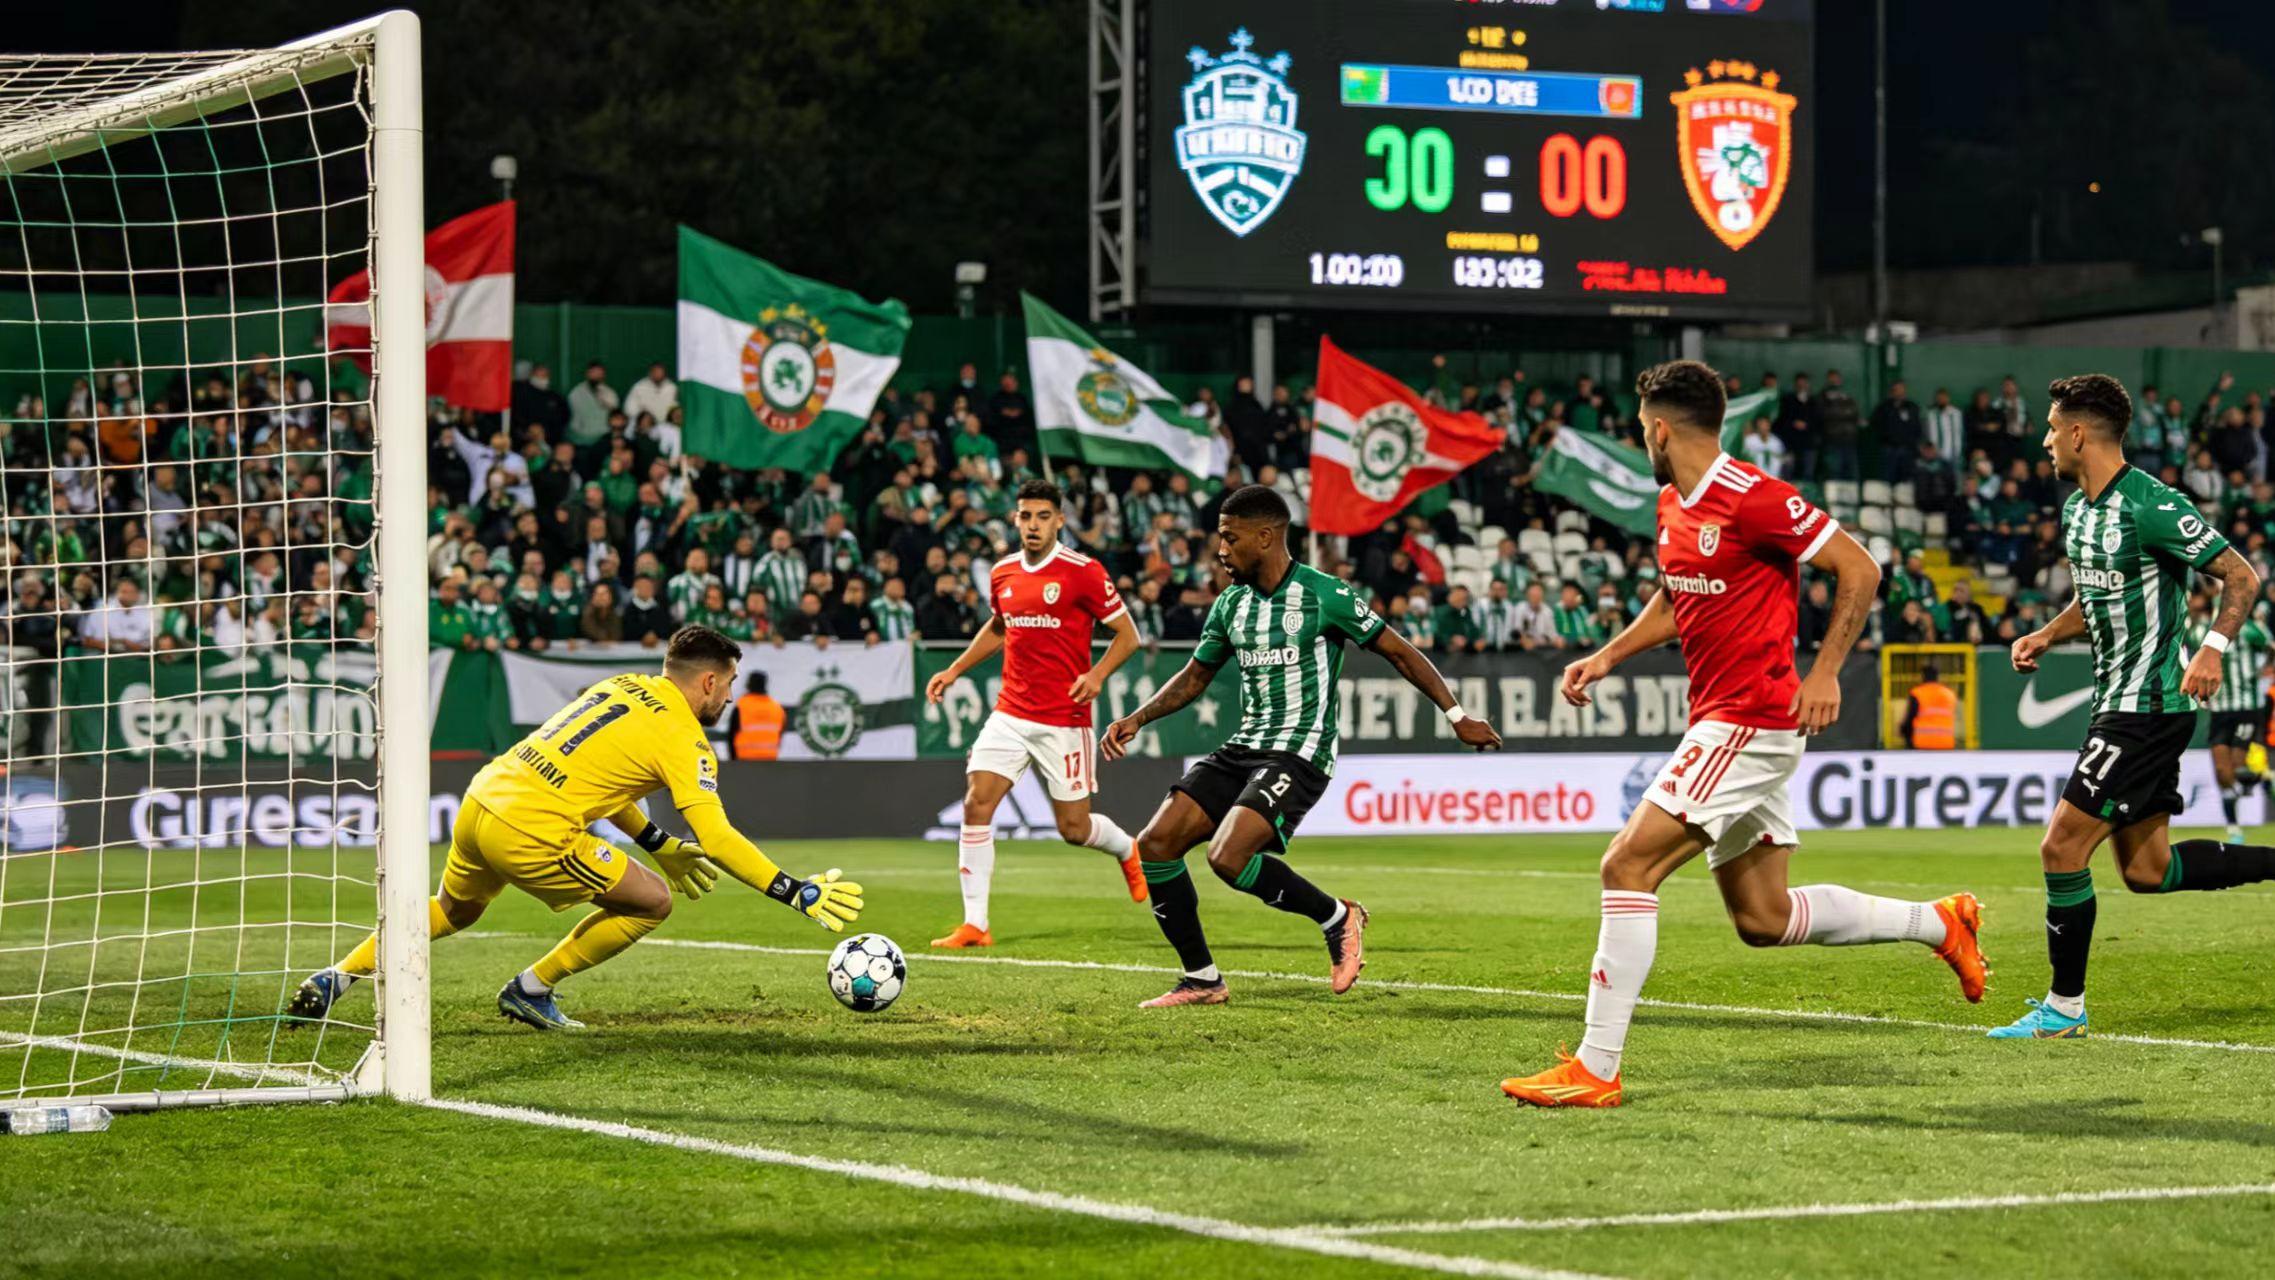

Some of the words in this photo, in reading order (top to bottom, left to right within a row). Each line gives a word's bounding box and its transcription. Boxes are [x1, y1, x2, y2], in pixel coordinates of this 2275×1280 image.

[1365, 125, 1454, 212] 30
[1539, 133, 1627, 219] 00
[2078, 736, 2123, 781] 27
[1345, 779, 1595, 825] Guiveseneto
